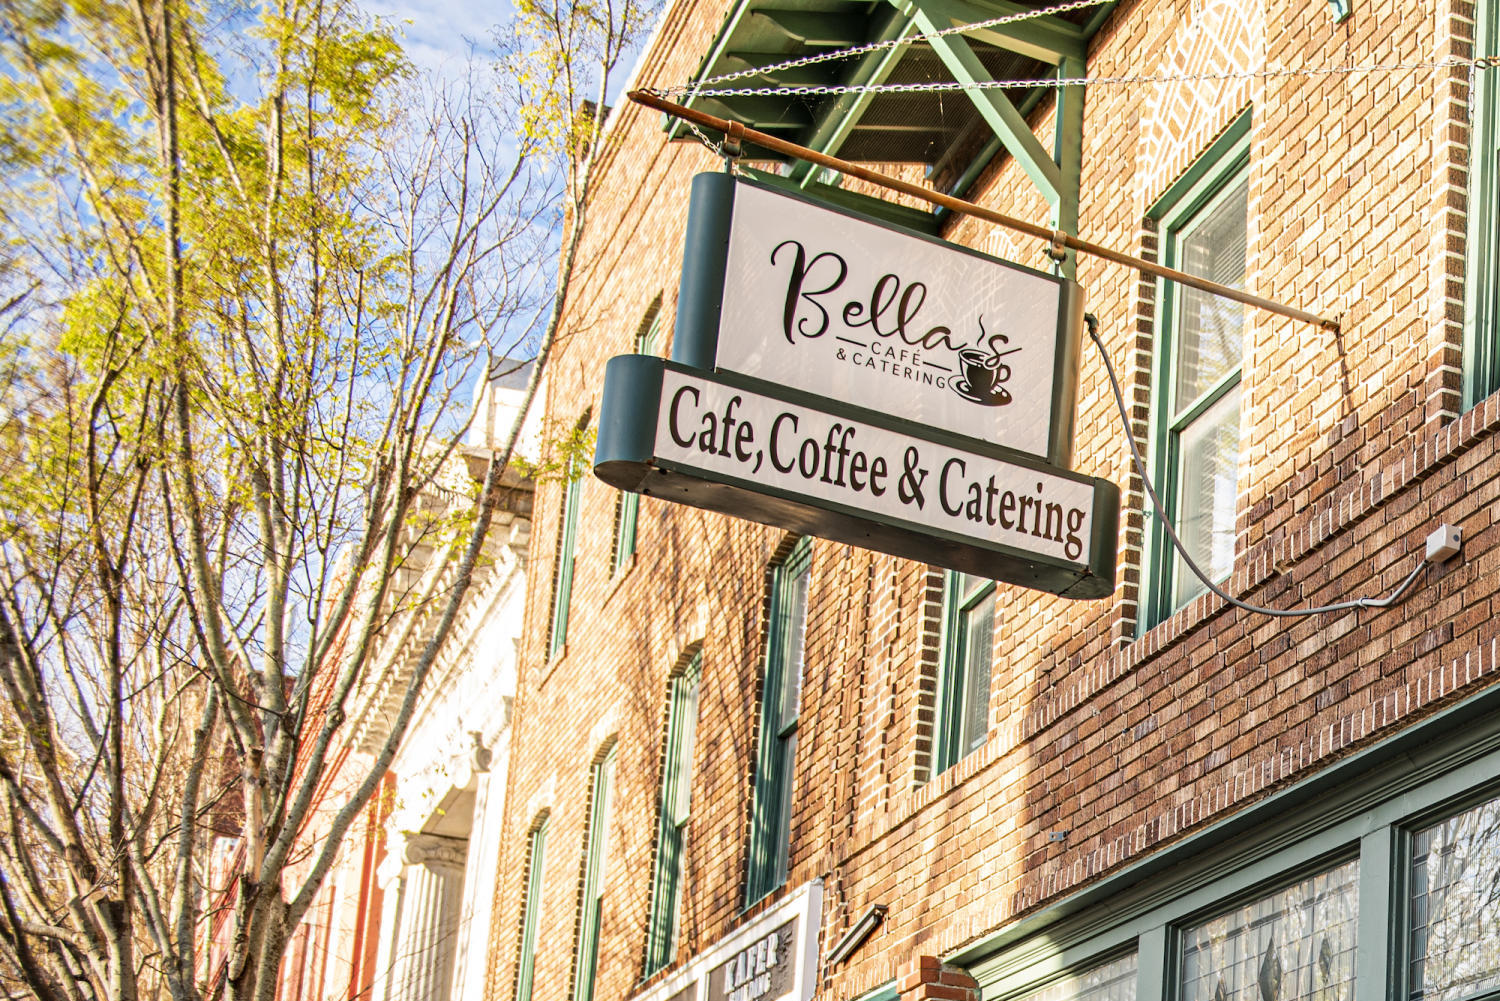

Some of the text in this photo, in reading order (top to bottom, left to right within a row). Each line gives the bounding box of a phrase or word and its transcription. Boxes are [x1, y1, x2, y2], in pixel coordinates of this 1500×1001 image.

[770, 240, 1022, 369] Bella's
[836, 347, 946, 390] & CATERING
[668, 385, 1086, 561] Cafe, Coffee & Catering
